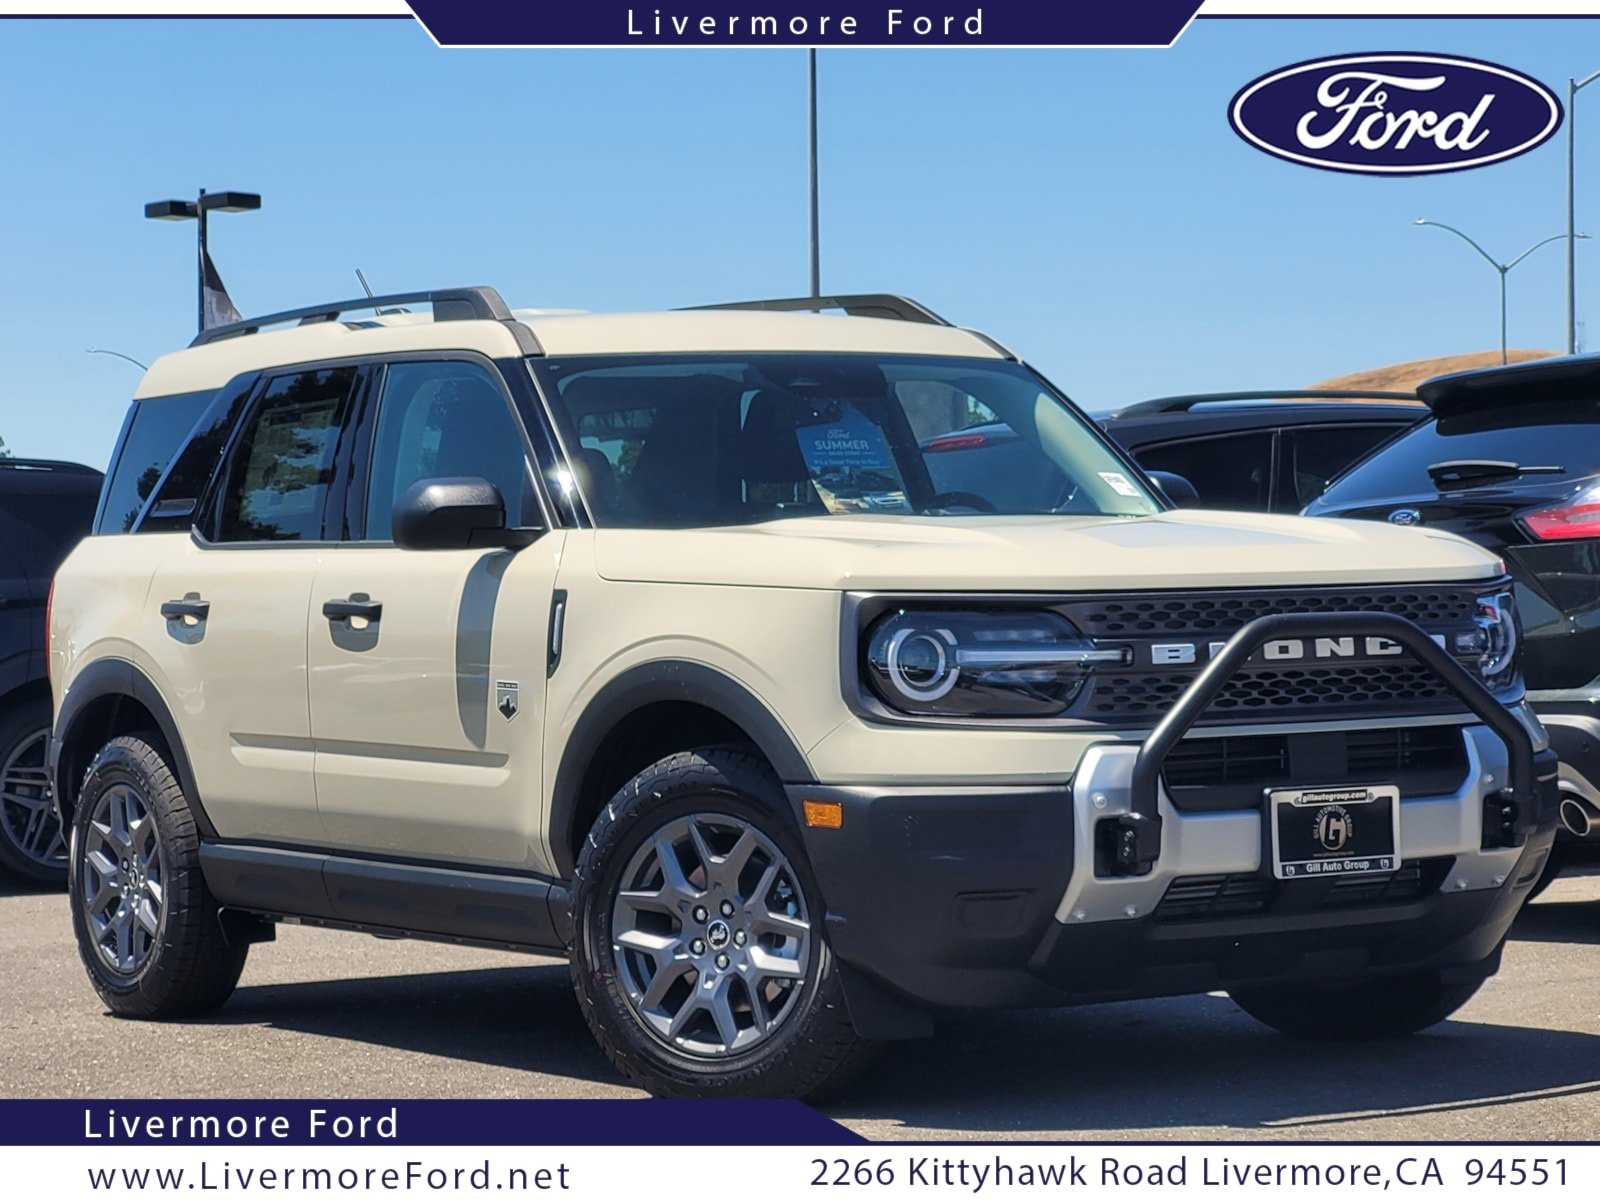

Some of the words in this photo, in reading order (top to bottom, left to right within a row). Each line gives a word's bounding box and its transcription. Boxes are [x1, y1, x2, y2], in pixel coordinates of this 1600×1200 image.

[827, 429, 850, 439] Ford
[814, 440, 870, 450] SUMMER
[1151, 634, 1446, 665] BONC
[1302, 791, 1366, 803] gillautogroup.com
[1315, 805, 1347, 823] AUTOMOTIVE
[1306, 863, 1321, 873] Gill
[1322, 861, 1342, 872] Auto
[1343, 860, 1370, 871] Group
